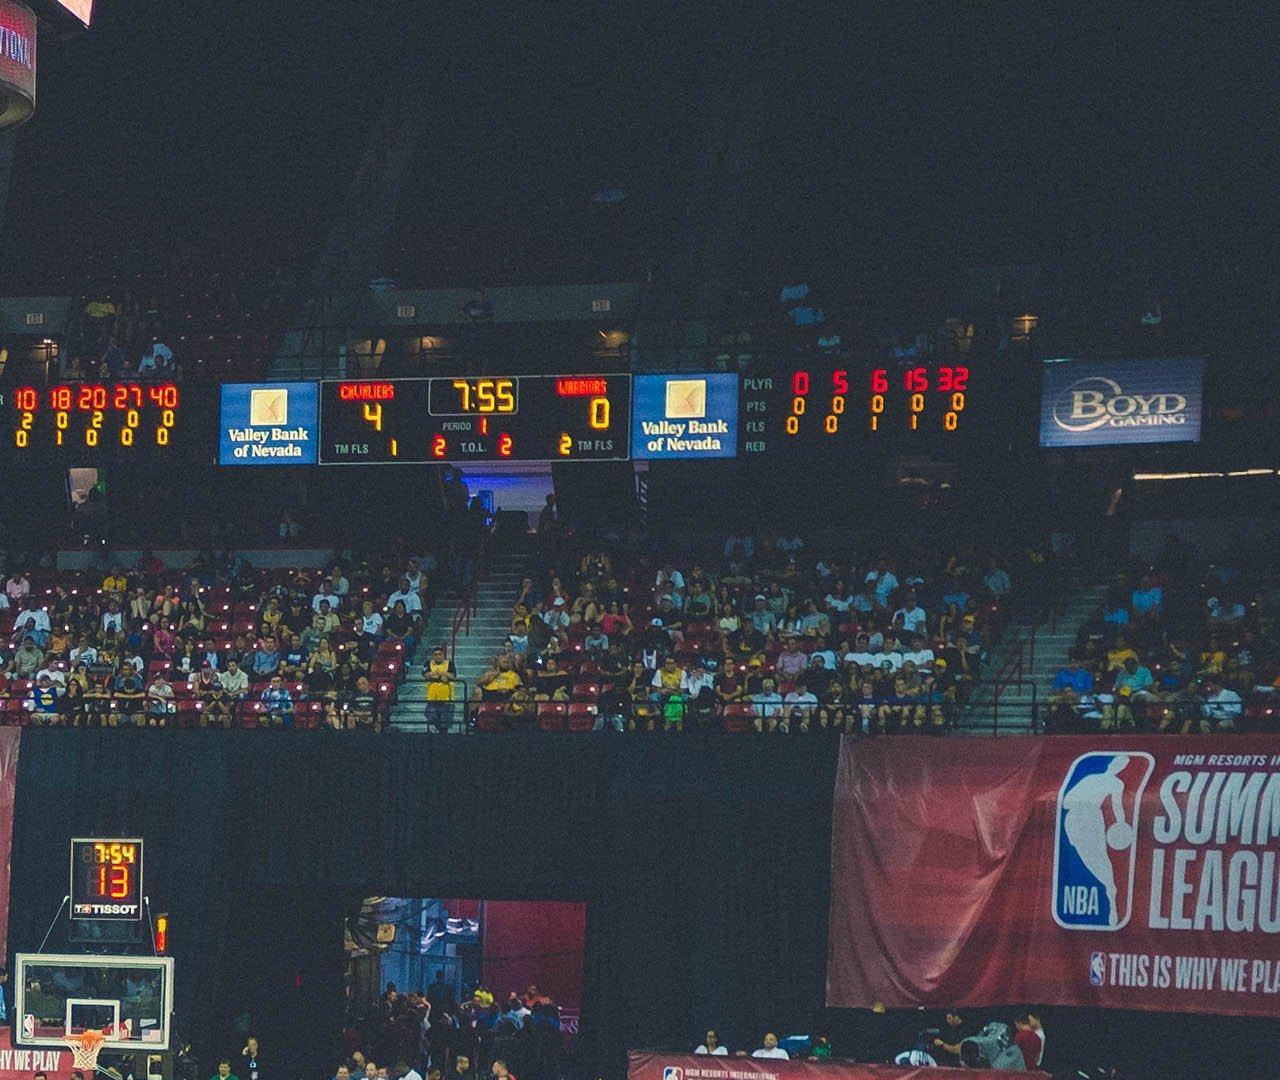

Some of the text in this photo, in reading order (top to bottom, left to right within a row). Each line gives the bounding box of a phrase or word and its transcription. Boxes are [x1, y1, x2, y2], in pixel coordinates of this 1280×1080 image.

[557, 379, 607, 395] WARRIORS
[744, 367, 969, 395] PLYR 0 5 6 15 32
[15, 389, 36, 410] 10
[51, 389, 71, 410] 18
[79, 388, 106, 409] 20
[115, 388, 141, 409] 27
[150, 387, 177, 408] 40
[340, 384, 394, 400] CAVALIERS
[453, 380, 515, 412] 7:55
[591, 397, 609, 429] 0
[747, 392, 964, 415] PTS 0 0 0 0 0
[1071, 391, 1186, 418] BOYD
[22, 413, 33, 430] 2
[57, 412, 68, 429] 0
[92, 411, 103, 429] 2
[128, 411, 138, 428] 0
[163, 410, 174, 427] 0
[363, 403, 382, 431] 4
[747, 422, 765, 432] FLS
[786, 416, 798, 434] 0
[826, 415, 837, 433] 0
[945, 412, 957, 431] 0
[1109, 414, 1185, 427] GAMING
[16, 430, 27, 447] 0
[86, 429, 98, 447] 0
[122, 429, 133, 446] 0
[157, 428, 168, 446] 0
[229, 427, 308, 444] Valley Bank
[642, 420, 728, 435] Valley Bank
[234, 445, 301, 458] of Nevada
[335, 439, 397, 456] TM FLS 1
[433, 436, 512, 456] 2 T.O.L. 2
[560, 434, 613, 455] 2 TM FLS
[648, 437, 720, 452] of Nevada
[746, 442, 765, 451] REB
[1174, 755, 1204, 766] MGM
[1208, 755, 1267, 766] RESORTS
[95, 844, 134, 864] 7:54
[100, 865, 128, 898] 13
[93, 904, 137, 914] TISSOT
[1063, 886, 1099, 915] NBA
[1109, 953, 1149, 987] THIS
[1152, 955, 1172, 988] IS
[1175, 957, 1220, 990] WHY
[1221, 958, 1248, 992] WE
[14, 1051, 32, 1071] WE
[33, 1051, 60, 1072] PLAY
